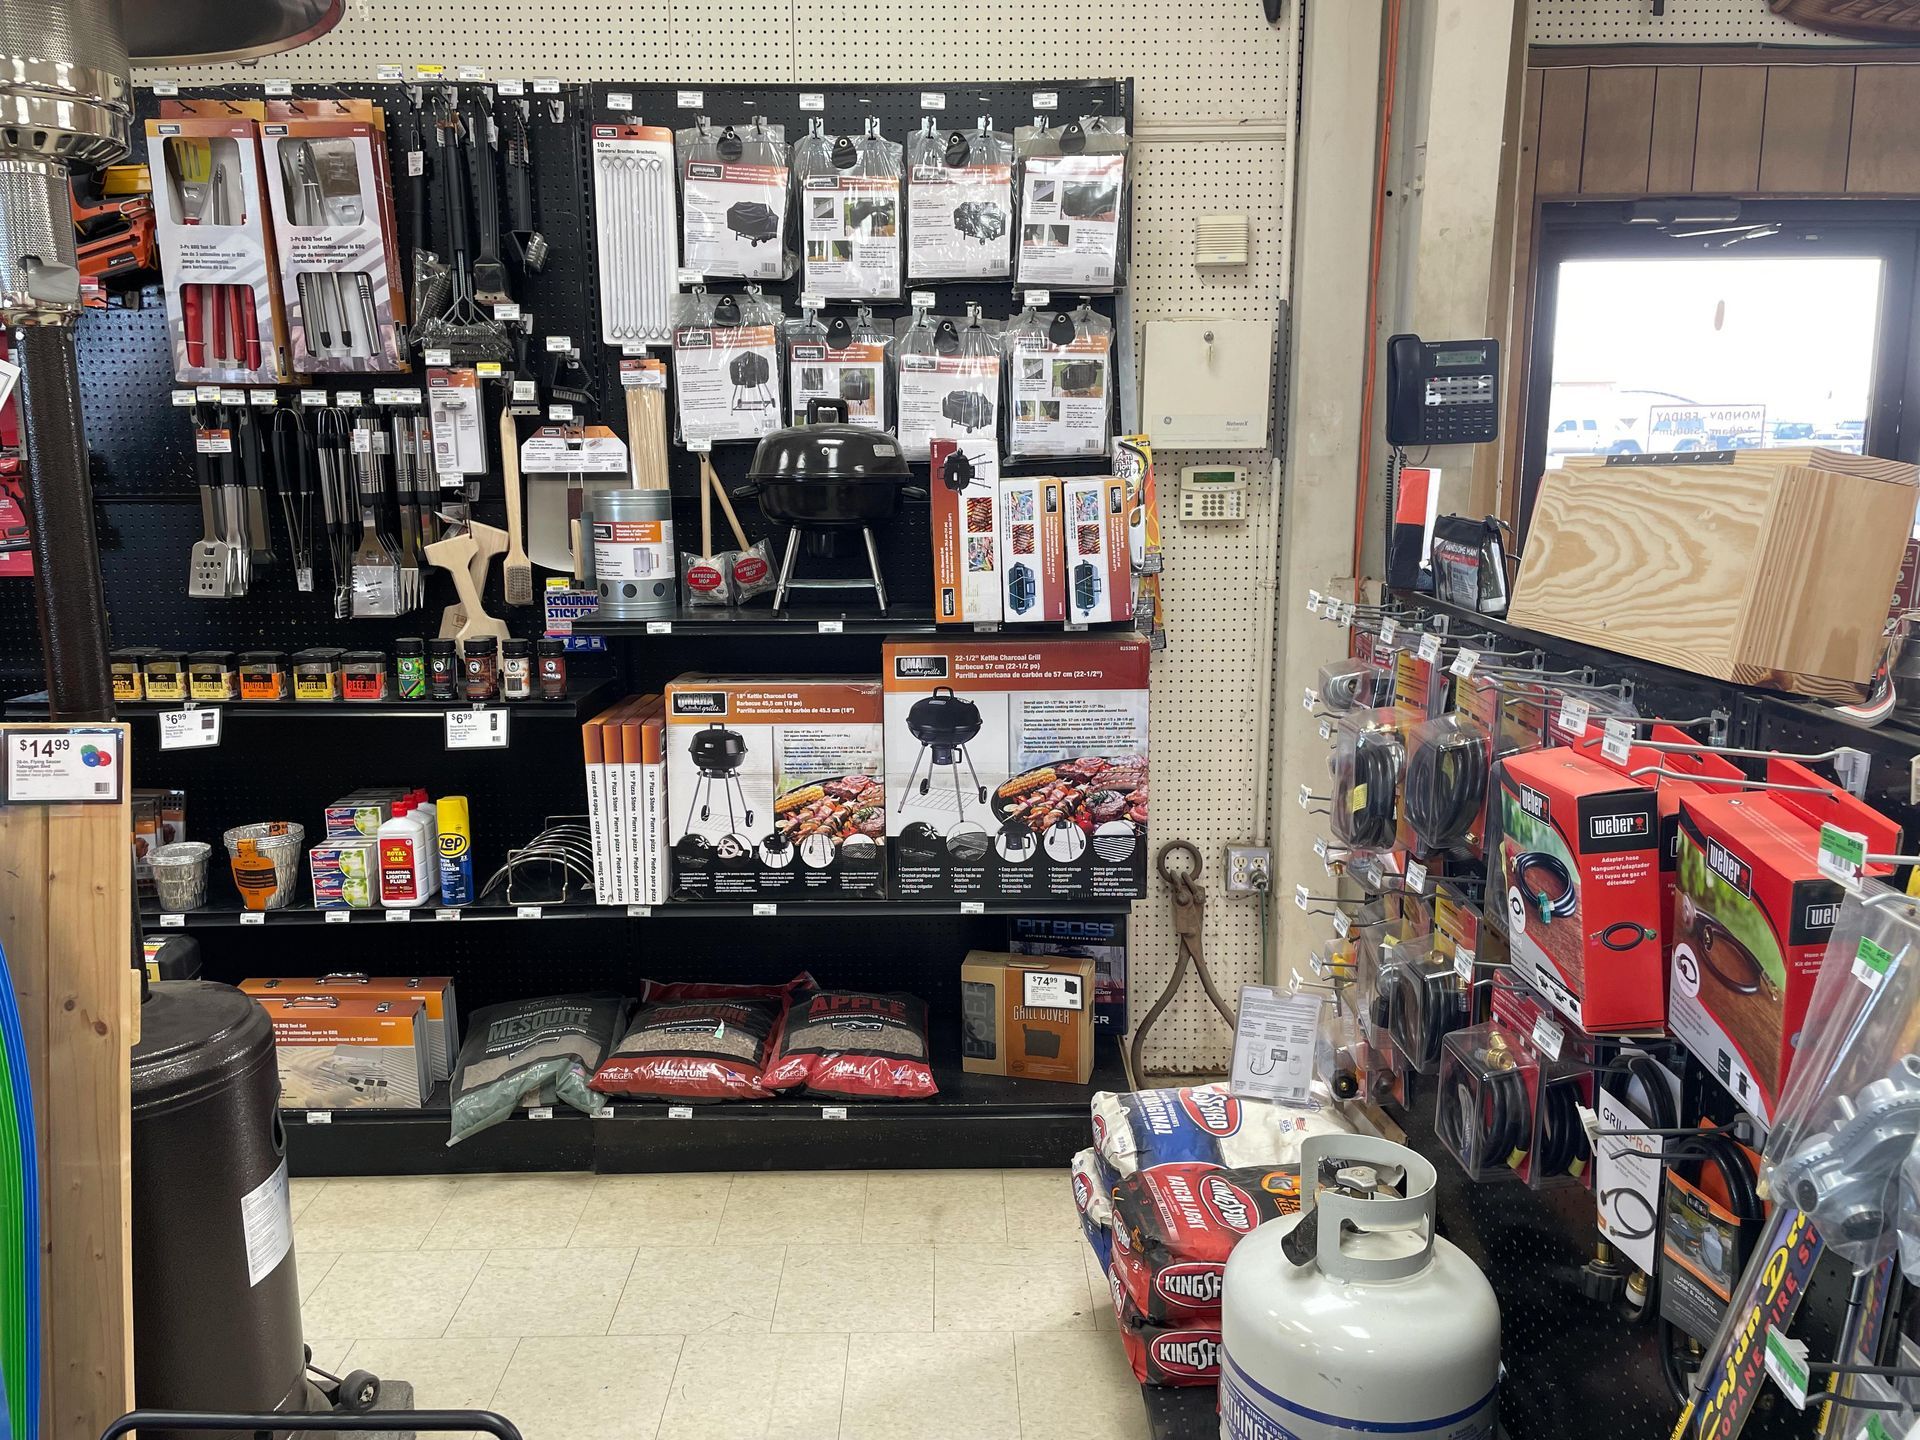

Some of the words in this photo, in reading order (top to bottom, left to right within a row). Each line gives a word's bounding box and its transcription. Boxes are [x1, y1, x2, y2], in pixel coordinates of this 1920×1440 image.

[548, 608, 578, 618] STICK
[1520, 786, 1542, 820] weber
[1594, 817, 1633, 835] weber
[1591, 862, 1650, 872] Manguera/adaptador
[1710, 844, 1740, 884] weber
[1812, 904, 1839, 925] web
[1018, 919, 1051, 934] PIT
[1053, 920, 1114, 936] BOSS
[810, 996, 906, 1014] APPLE
[808, 1015, 834, 1023] TRUSTED
[885, 1017, 907, 1026] FLAVOR
[1040, 1008, 1070, 1024] COVER
[488, 1010, 591, 1042] MESQUITE
[486, 1044, 513, 1053] TRUSTED
[654, 1069, 708, 1077] SIGNATURE
[1210, 1179, 1250, 1228] KINGSFORD
[1165, 1272, 1222, 1301] KINGSF
[1677, 1274, 1705, 1300] UNIVERSAL
[1673, 1278, 1688, 1291] HOSE
[1694, 1294, 1718, 1315] ADAPTER
[1247, 1407, 1266, 1428] SINCE
